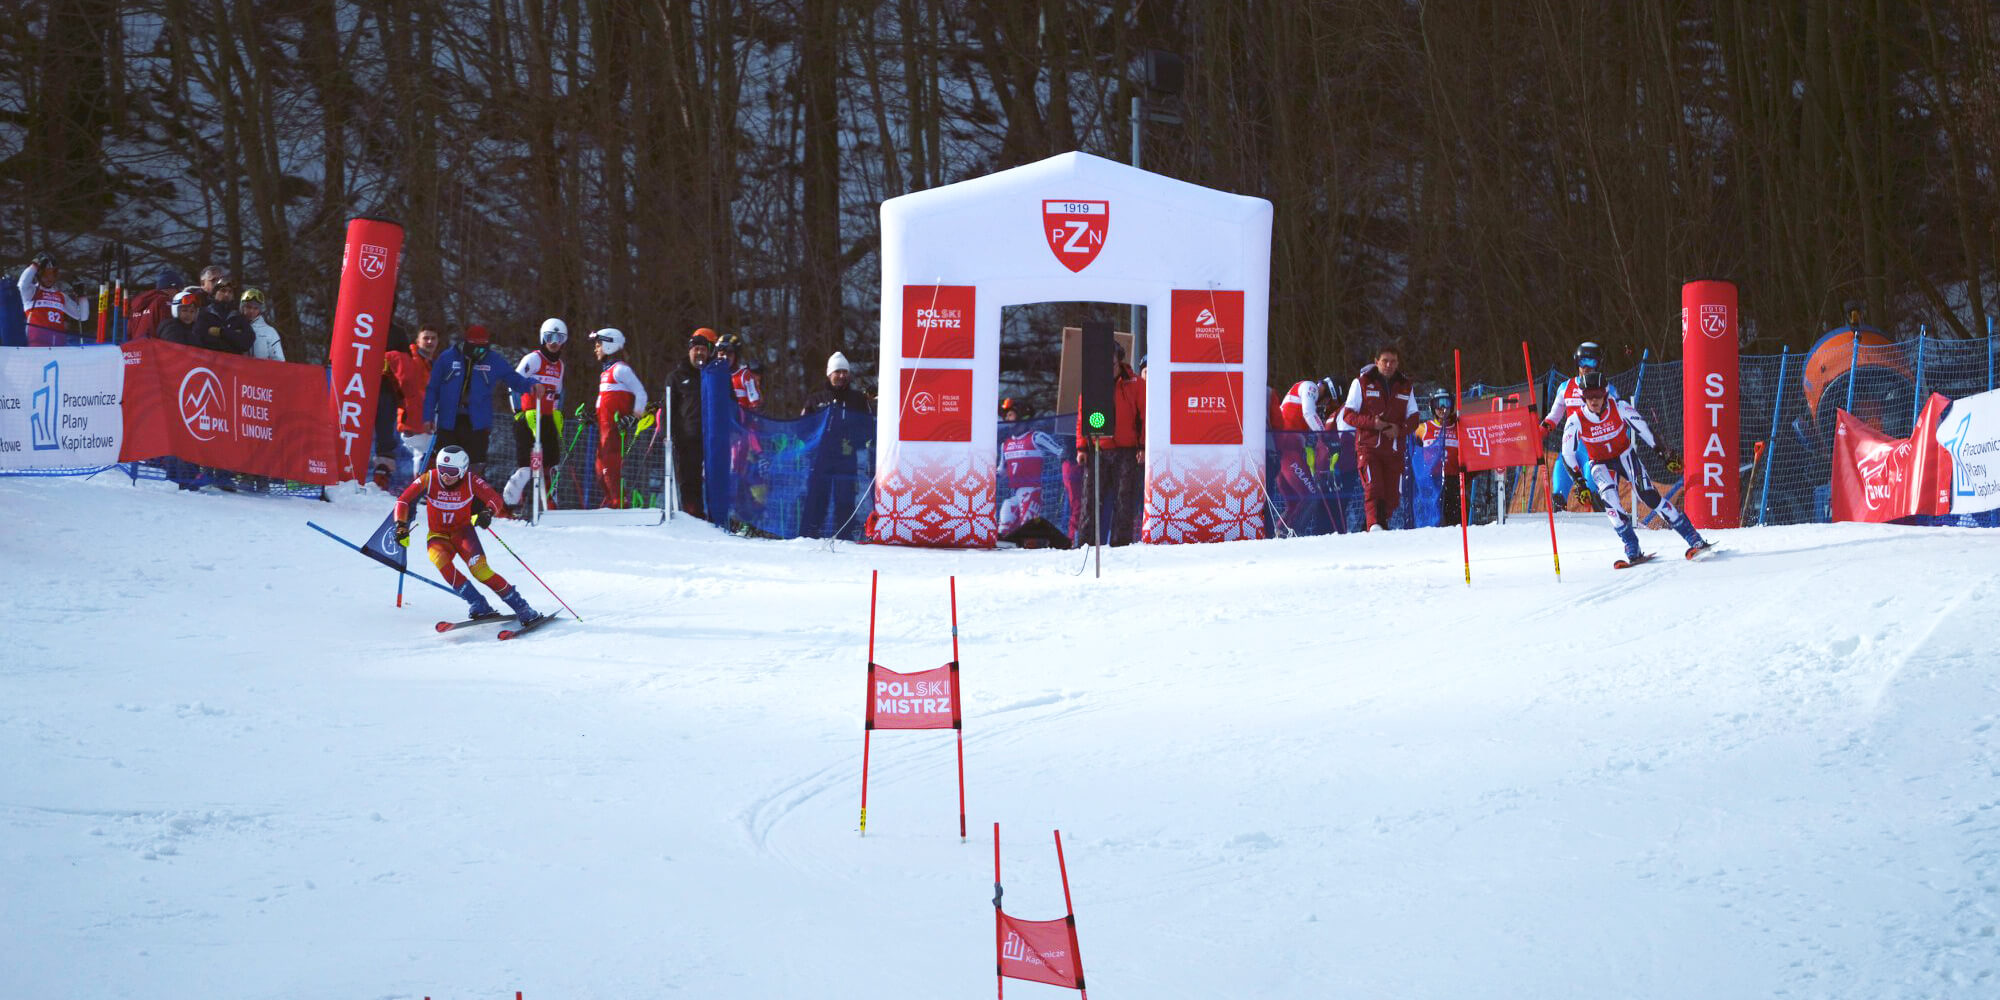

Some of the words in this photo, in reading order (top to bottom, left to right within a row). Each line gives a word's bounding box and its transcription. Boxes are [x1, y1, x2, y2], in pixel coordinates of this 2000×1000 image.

[1063, 203, 1090, 213] 1919
[1053, 220, 1102, 253] PZN
[47, 311, 62, 324] 82
[916, 309, 961, 318] POLSKI
[916, 319, 961, 328] MISTRZ
[341, 313, 374, 456] START
[62, 391, 116, 408] Pracownicze
[241, 384, 273, 403] POLSKIE
[1200, 397, 1227, 408] PFR
[241, 403, 270, 421] KOLEJE
[62, 414, 88, 431] Plany
[212, 417, 230, 432] PKL
[241, 423, 273, 441] LINOWE
[61, 434, 114, 452] Kapitałowe
[1605, 443, 1612, 453] 1
[1703, 373, 1726, 516] START
[1011, 462, 1018, 475] 7
[1290, 462, 1316, 494] POLAND
[442, 511, 455, 524] 17
[876, 680, 950, 697] POLSKI
[876, 697, 950, 714] MISTRZ
